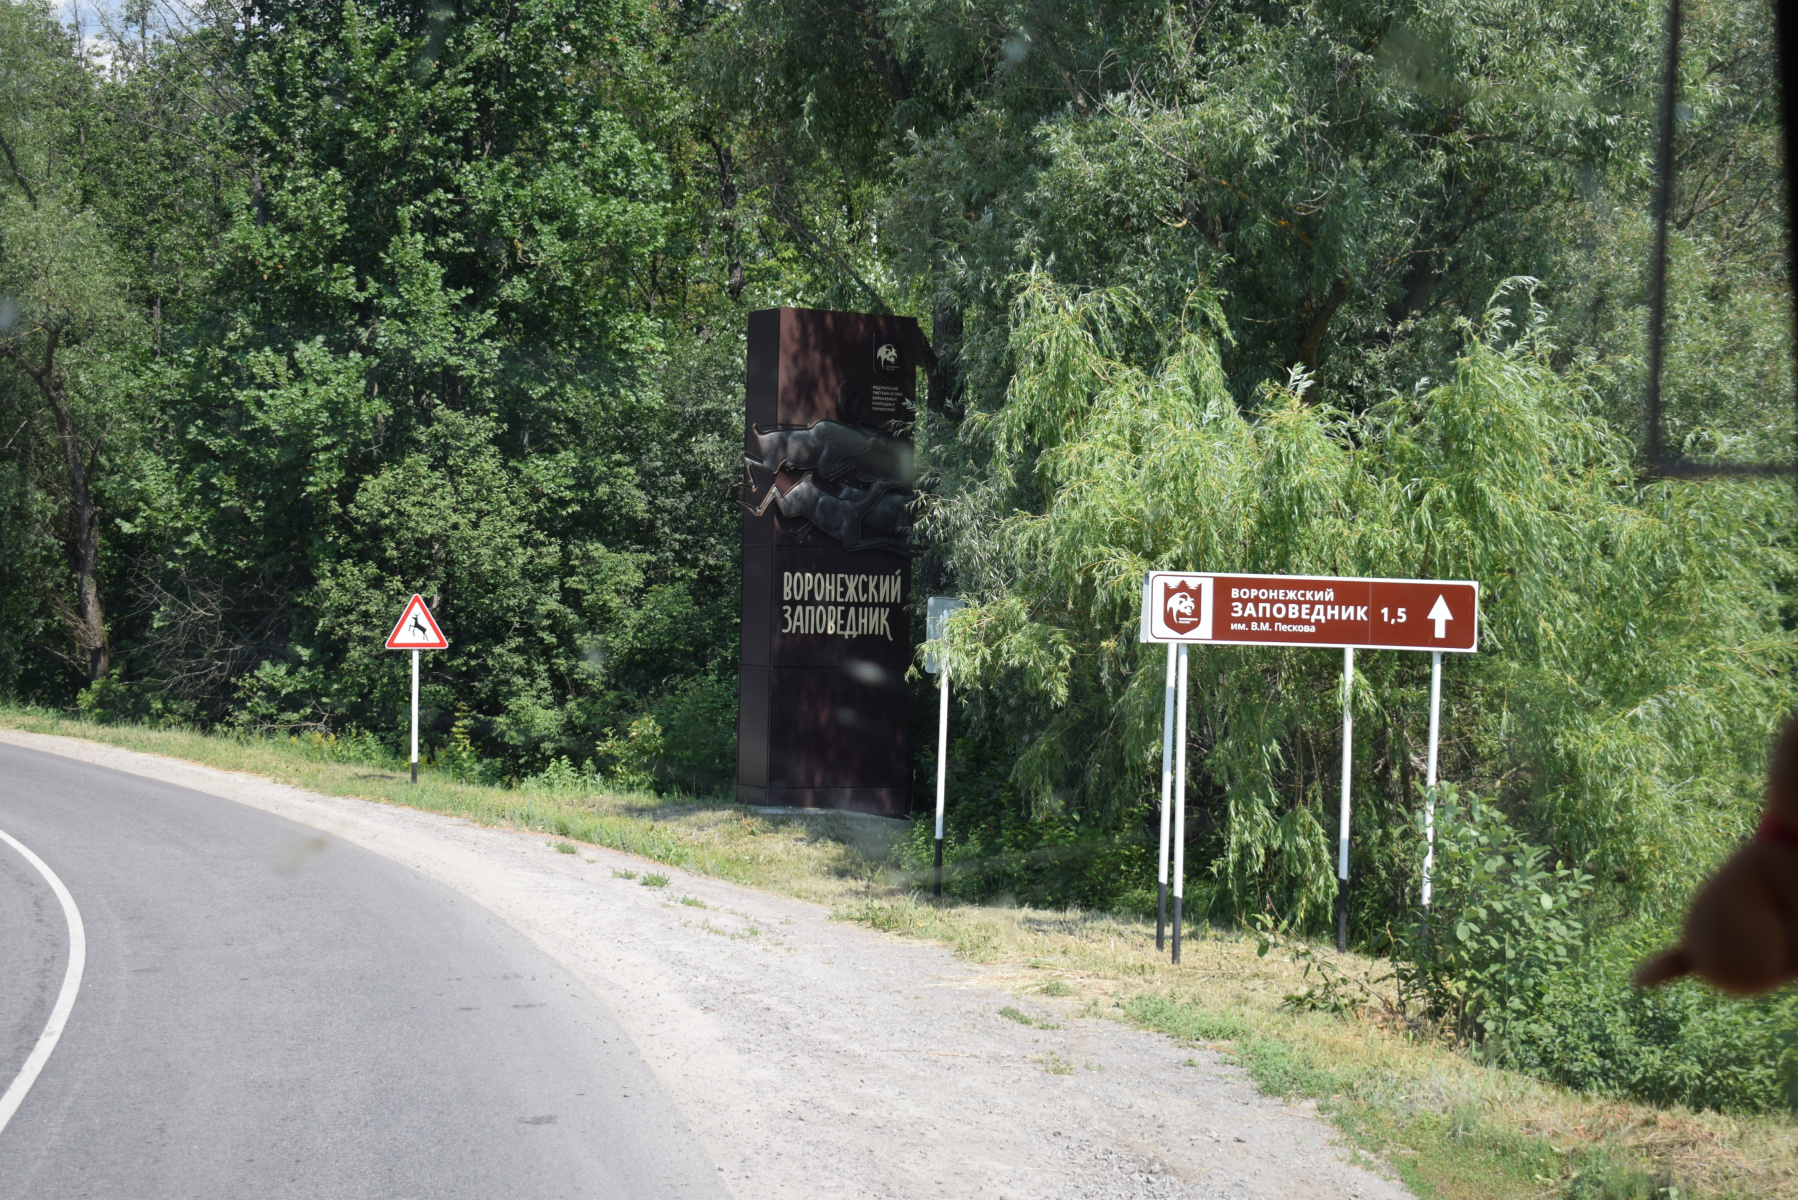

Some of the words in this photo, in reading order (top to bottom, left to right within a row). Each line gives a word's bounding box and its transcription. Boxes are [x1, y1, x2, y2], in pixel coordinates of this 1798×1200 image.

[783, 568, 901, 603] ВОРОНЕЖСКИЙ
[1231, 587, 1335, 602] ВОРОНЕЖСКИЙ
[1230, 602, 1369, 623] ЗАПОВЕДНИК
[1380, 606, 1407, 625] 1,5
[781, 605, 893, 641] ЗАПОВЕДНИК
[1230, 622, 1248, 631] им.
[1250, 621, 1272, 631] В.М.
[1274, 622, 1316, 633] Пескова
